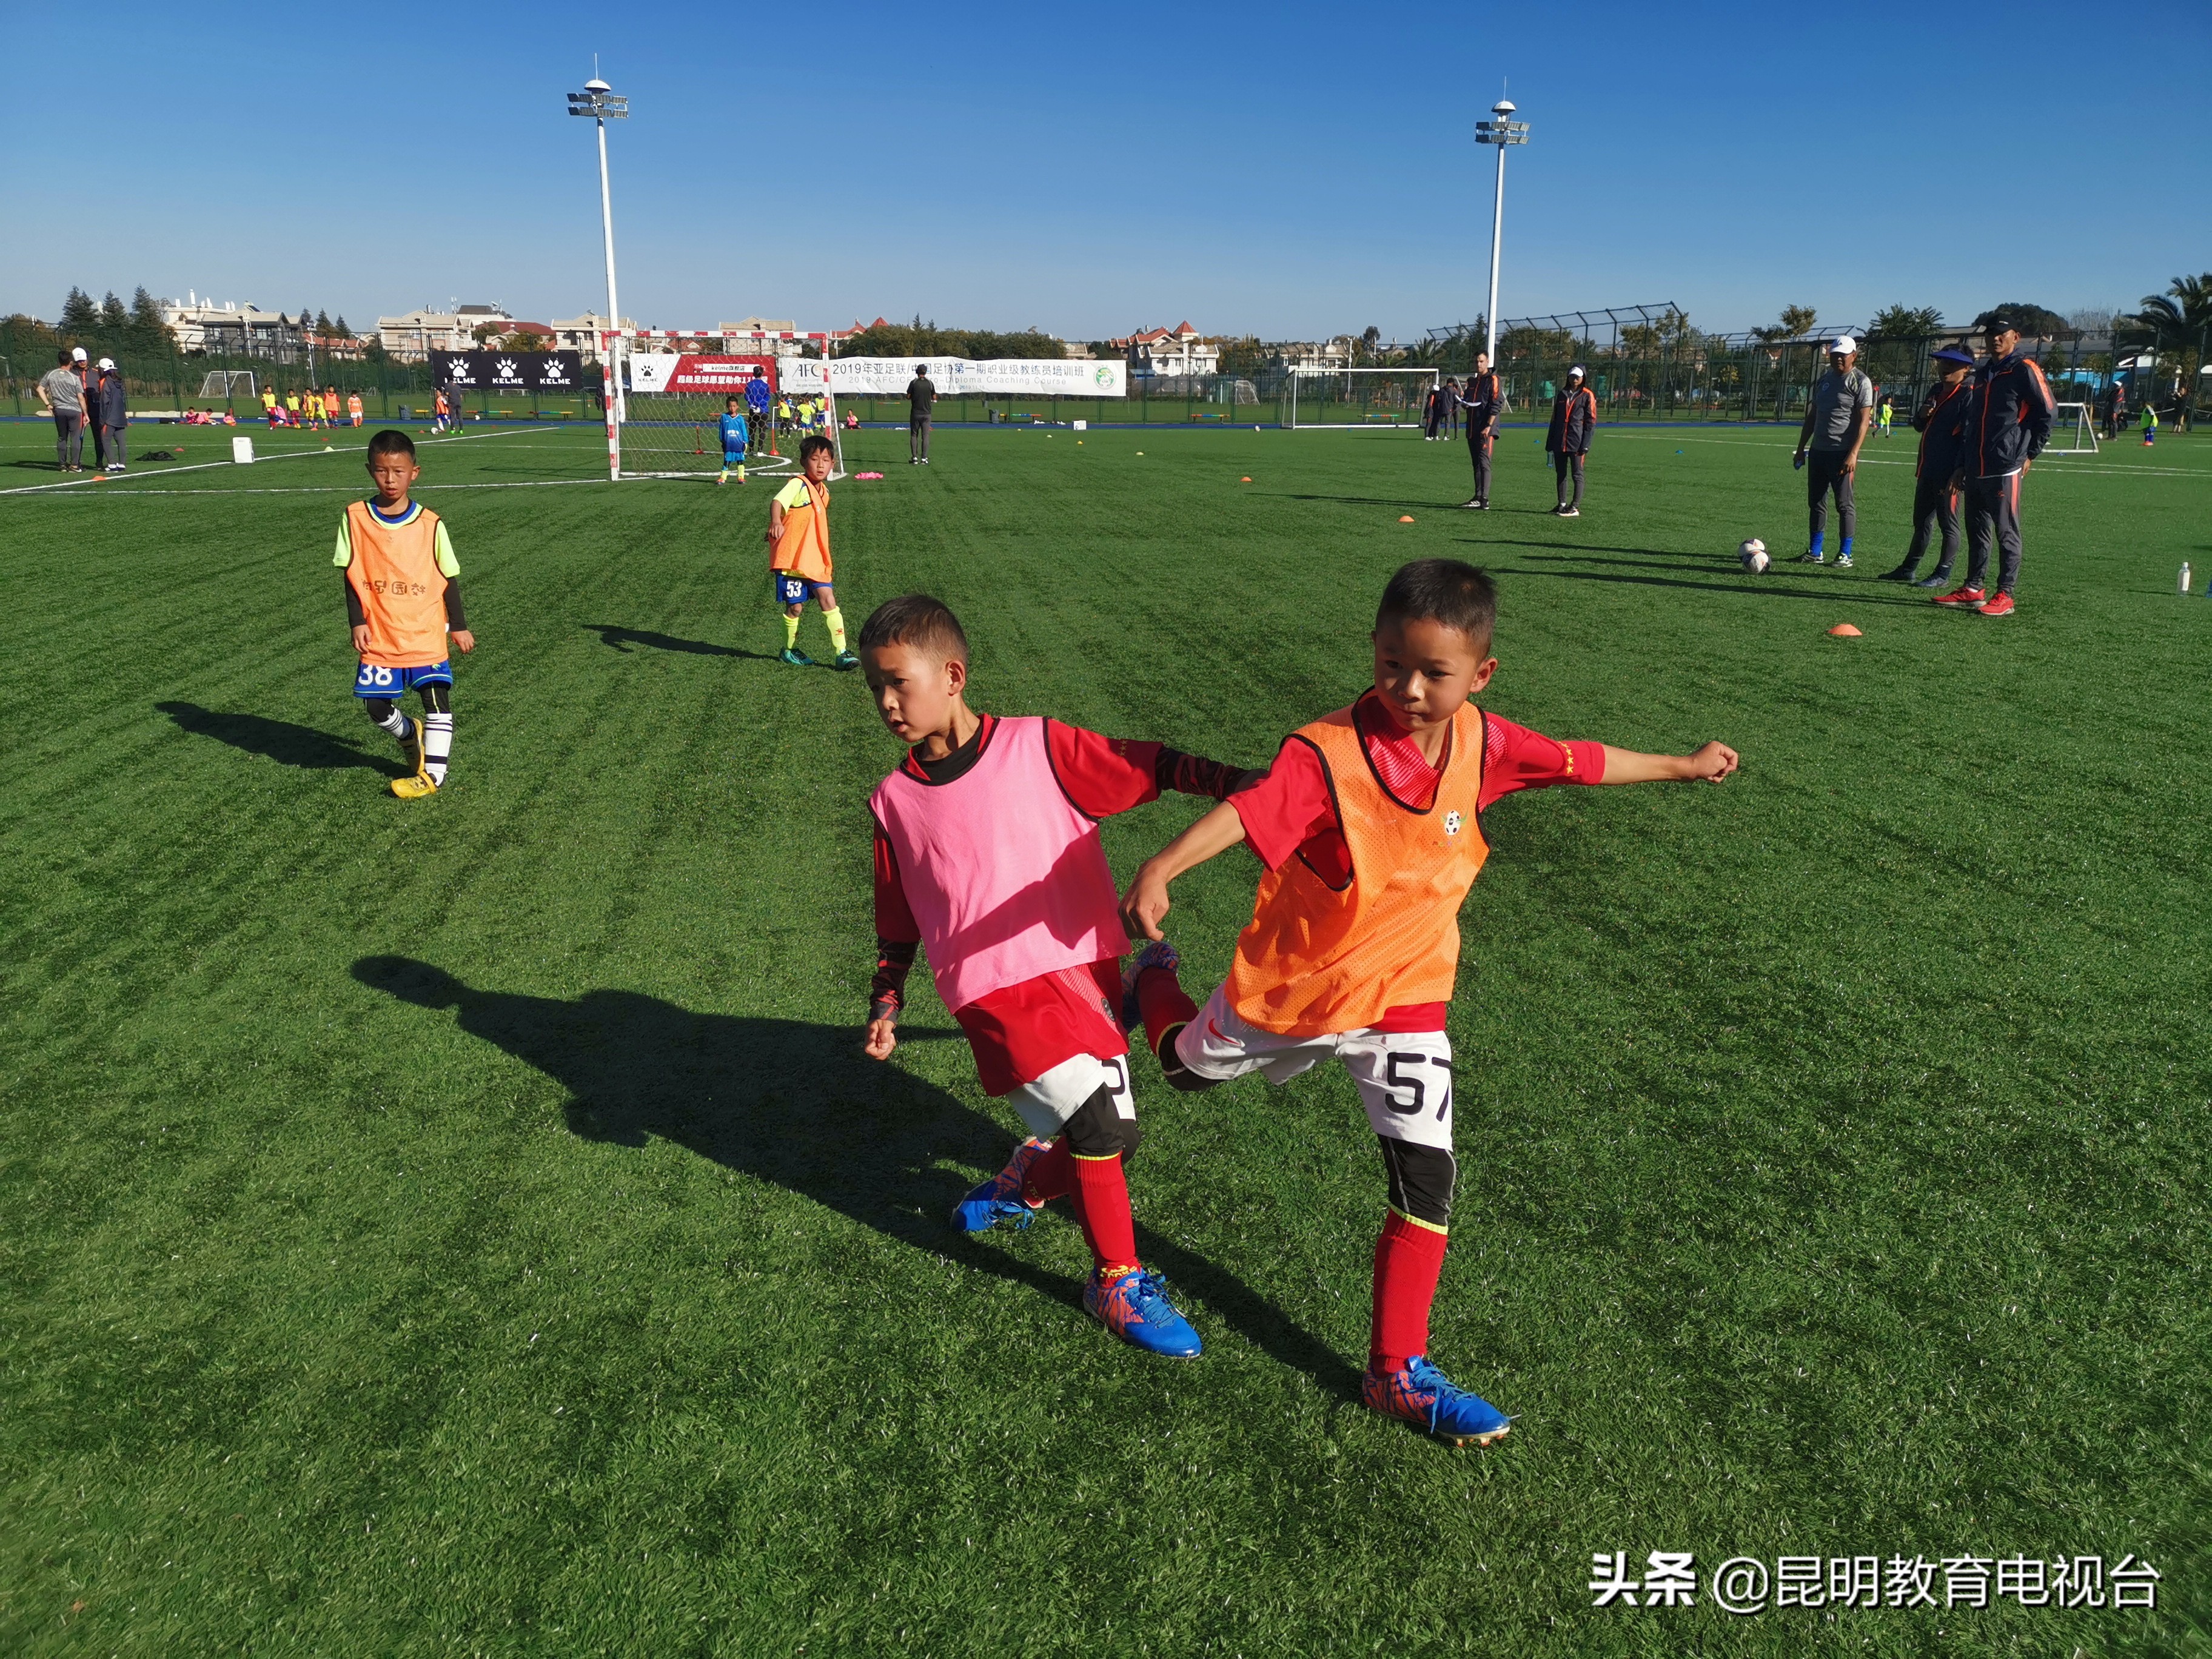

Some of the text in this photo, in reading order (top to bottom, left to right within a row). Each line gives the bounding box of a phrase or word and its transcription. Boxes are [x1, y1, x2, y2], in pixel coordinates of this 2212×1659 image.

[792, 363, 820, 377] AFC
[930, 376, 982, 385] ro-Diploma
[987, 376, 1030, 386] Coaching
[1034, 377, 1066, 385] Course
[786, 580, 802, 598] 53
[358, 665, 393, 686] 38
[1385, 1051, 1452, 1122] 57
